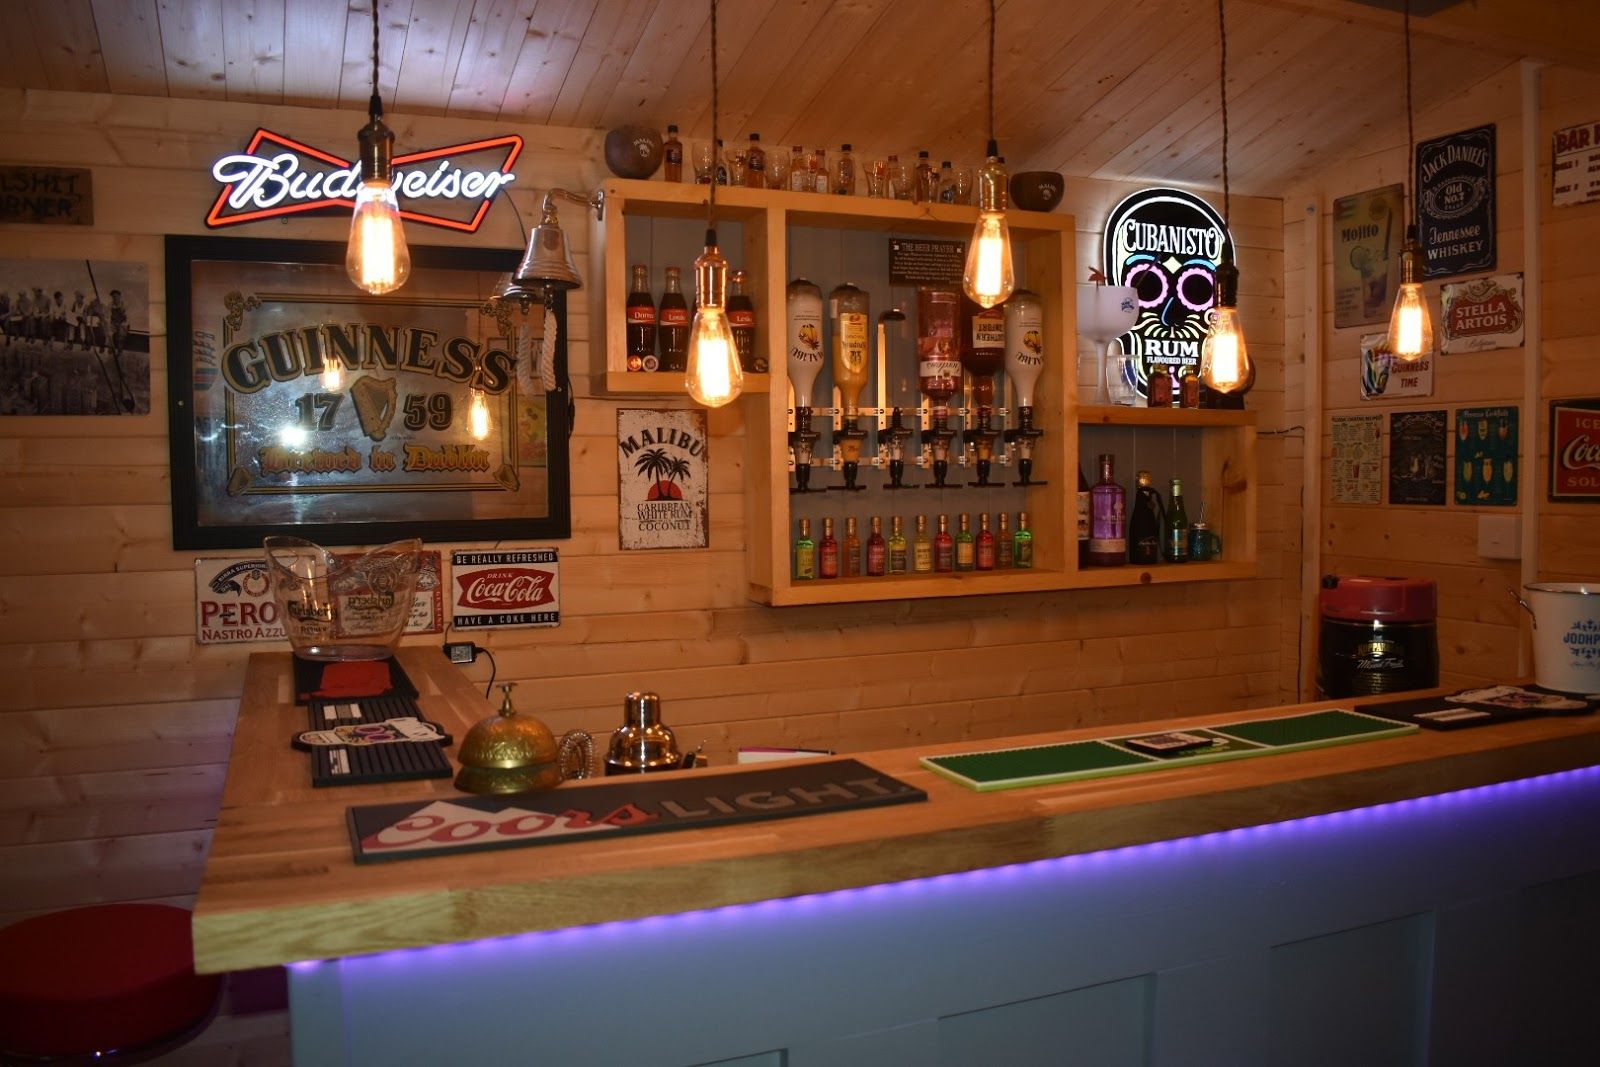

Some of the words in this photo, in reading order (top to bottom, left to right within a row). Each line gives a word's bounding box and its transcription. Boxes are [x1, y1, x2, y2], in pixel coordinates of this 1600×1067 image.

[1556, 129, 1589, 153] BAR
[1423, 152, 1447, 183] JACK
[212, 153, 514, 208] Budeiser
[1122, 219, 1220, 259] CUBANISTO
[1429, 223, 1481, 245] Tennessee
[1427, 240, 1484, 261] WHISKEY
[1455, 302, 1507, 318] STELLA
[1455, 314, 1508, 331] ARTOIS
[1144, 339, 1200, 358] RUM
[221, 324, 518, 395] GUINNESS
[1400, 376, 1419, 388] TIME
[295, 393, 345, 431] 17
[402, 393, 455, 431] 59
[619, 427, 705, 459] MALIBU
[402, 443, 491, 473] Dublin
[637, 502, 692, 512] CARIBBEAN
[637, 510, 659, 520] WHITE
[670, 510, 692, 519] RUM
[638, 522, 691, 532] COCONUT
[456, 555, 468, 564] BE
[471, 554, 504, 564] REALLY
[506, 552, 554, 563] REFRESHED
[486, 572, 515, 580] DRINK
[466, 575, 546, 604] Coca-Cola
[457, 615, 482, 626] HAVE
[488, 615, 494, 625] A
[499, 614, 525, 624] COKE
[530, 612, 555, 623] HERE
[361, 802, 660, 848] Coors
[660, 777, 890, 818] LIGHT
